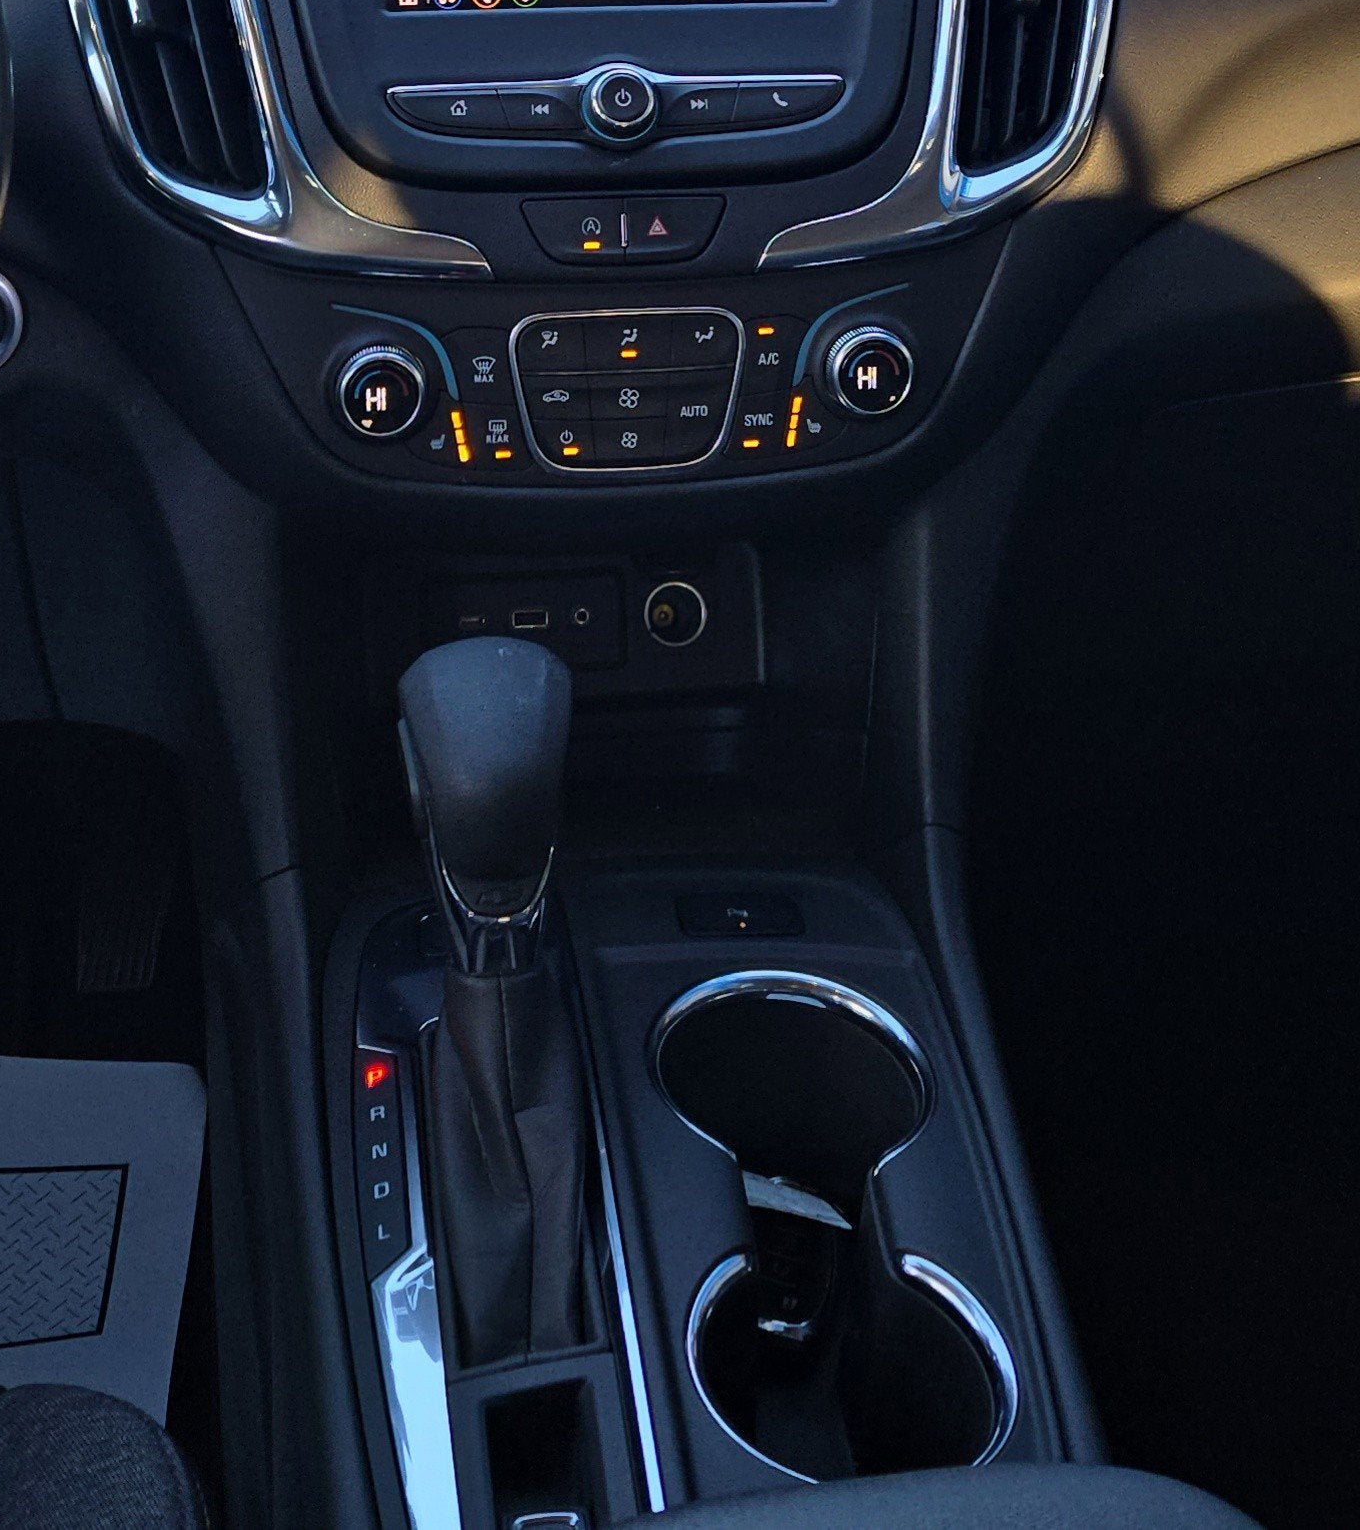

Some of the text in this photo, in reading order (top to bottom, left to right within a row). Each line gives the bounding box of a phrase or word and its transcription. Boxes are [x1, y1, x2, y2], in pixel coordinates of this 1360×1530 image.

[758, 352, 780, 365] A/C
[474, 374, 494, 383] MAX
[857, 366, 878, 390] HI
[365, 388, 387, 412] HI
[680, 405, 708, 417] AUTO
[744, 413, 774, 427] SYNC
[486, 434, 509, 443] REAR
[366, 1069, 384, 1088] P
[370, 1105, 385, 1122] R
[372, 1142, 388, 1160] N
[373, 1181, 390, 1200] D
[378, 1224, 390, 1241] L
